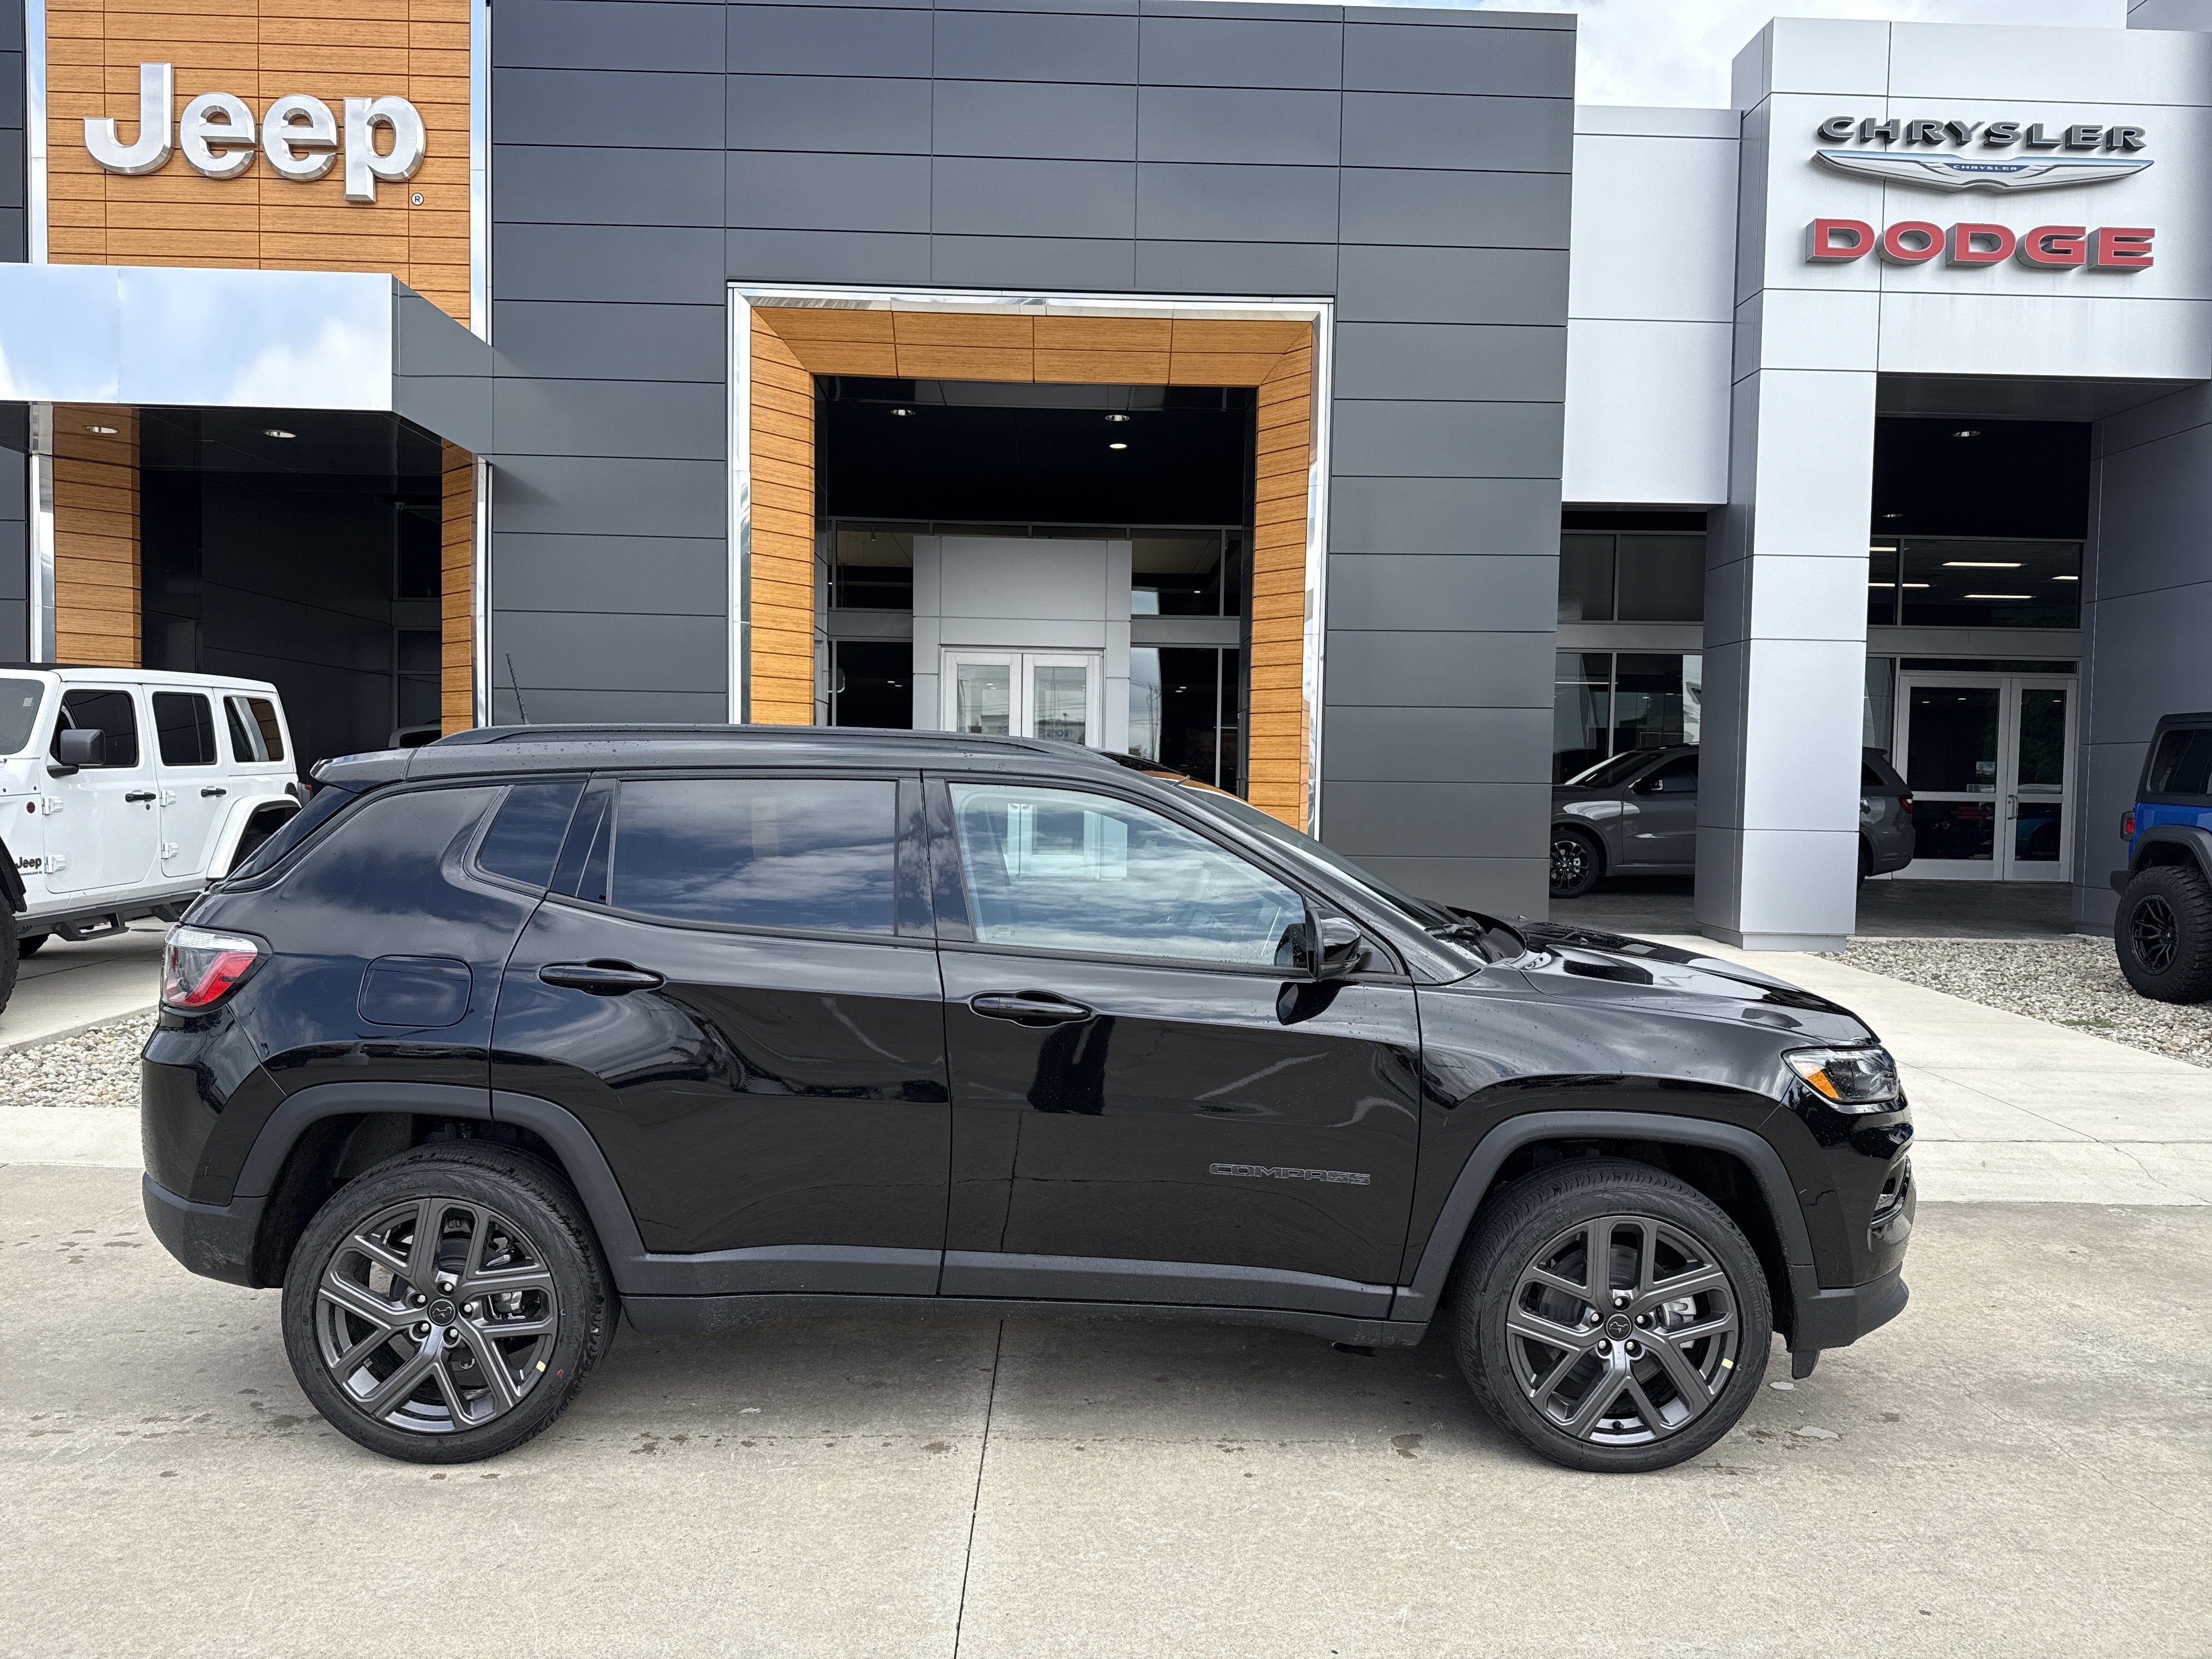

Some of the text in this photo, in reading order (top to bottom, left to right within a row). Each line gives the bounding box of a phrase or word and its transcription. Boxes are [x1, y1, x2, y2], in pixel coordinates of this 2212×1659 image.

[83, 63, 426, 202] Jeep
[1818, 116, 2146, 150] CHRYSLER
[1806, 218, 2155, 271] DODGE
[15, 856, 42, 869] Jeep
[400, 1181, 414, 1190] 95
[1209, 1163, 1370, 1186] COMPASS
